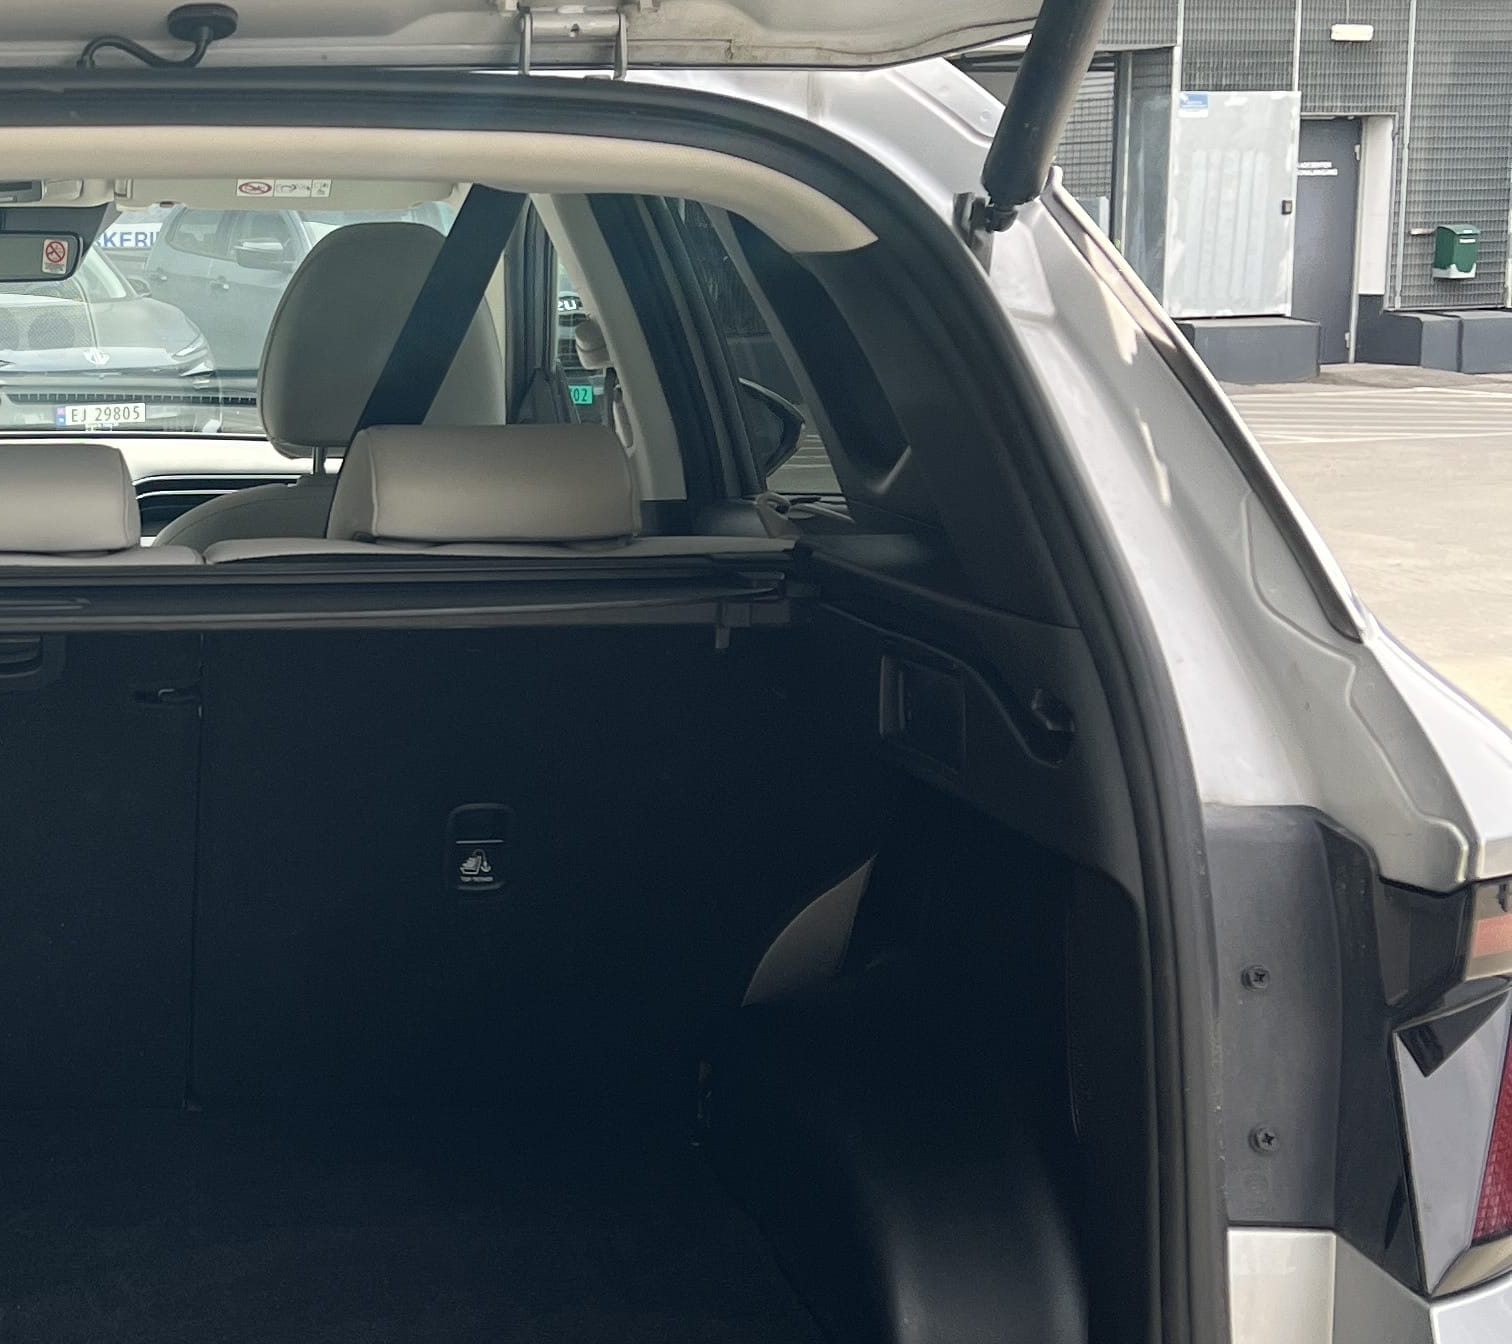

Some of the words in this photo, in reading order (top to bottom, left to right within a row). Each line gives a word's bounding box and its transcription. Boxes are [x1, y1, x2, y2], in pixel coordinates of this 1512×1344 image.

[97, 231, 154, 248] KERI
[571, 387, 588, 402] 02
[71, 408, 86, 422] EJ
[94, 406, 140, 421] 29805
